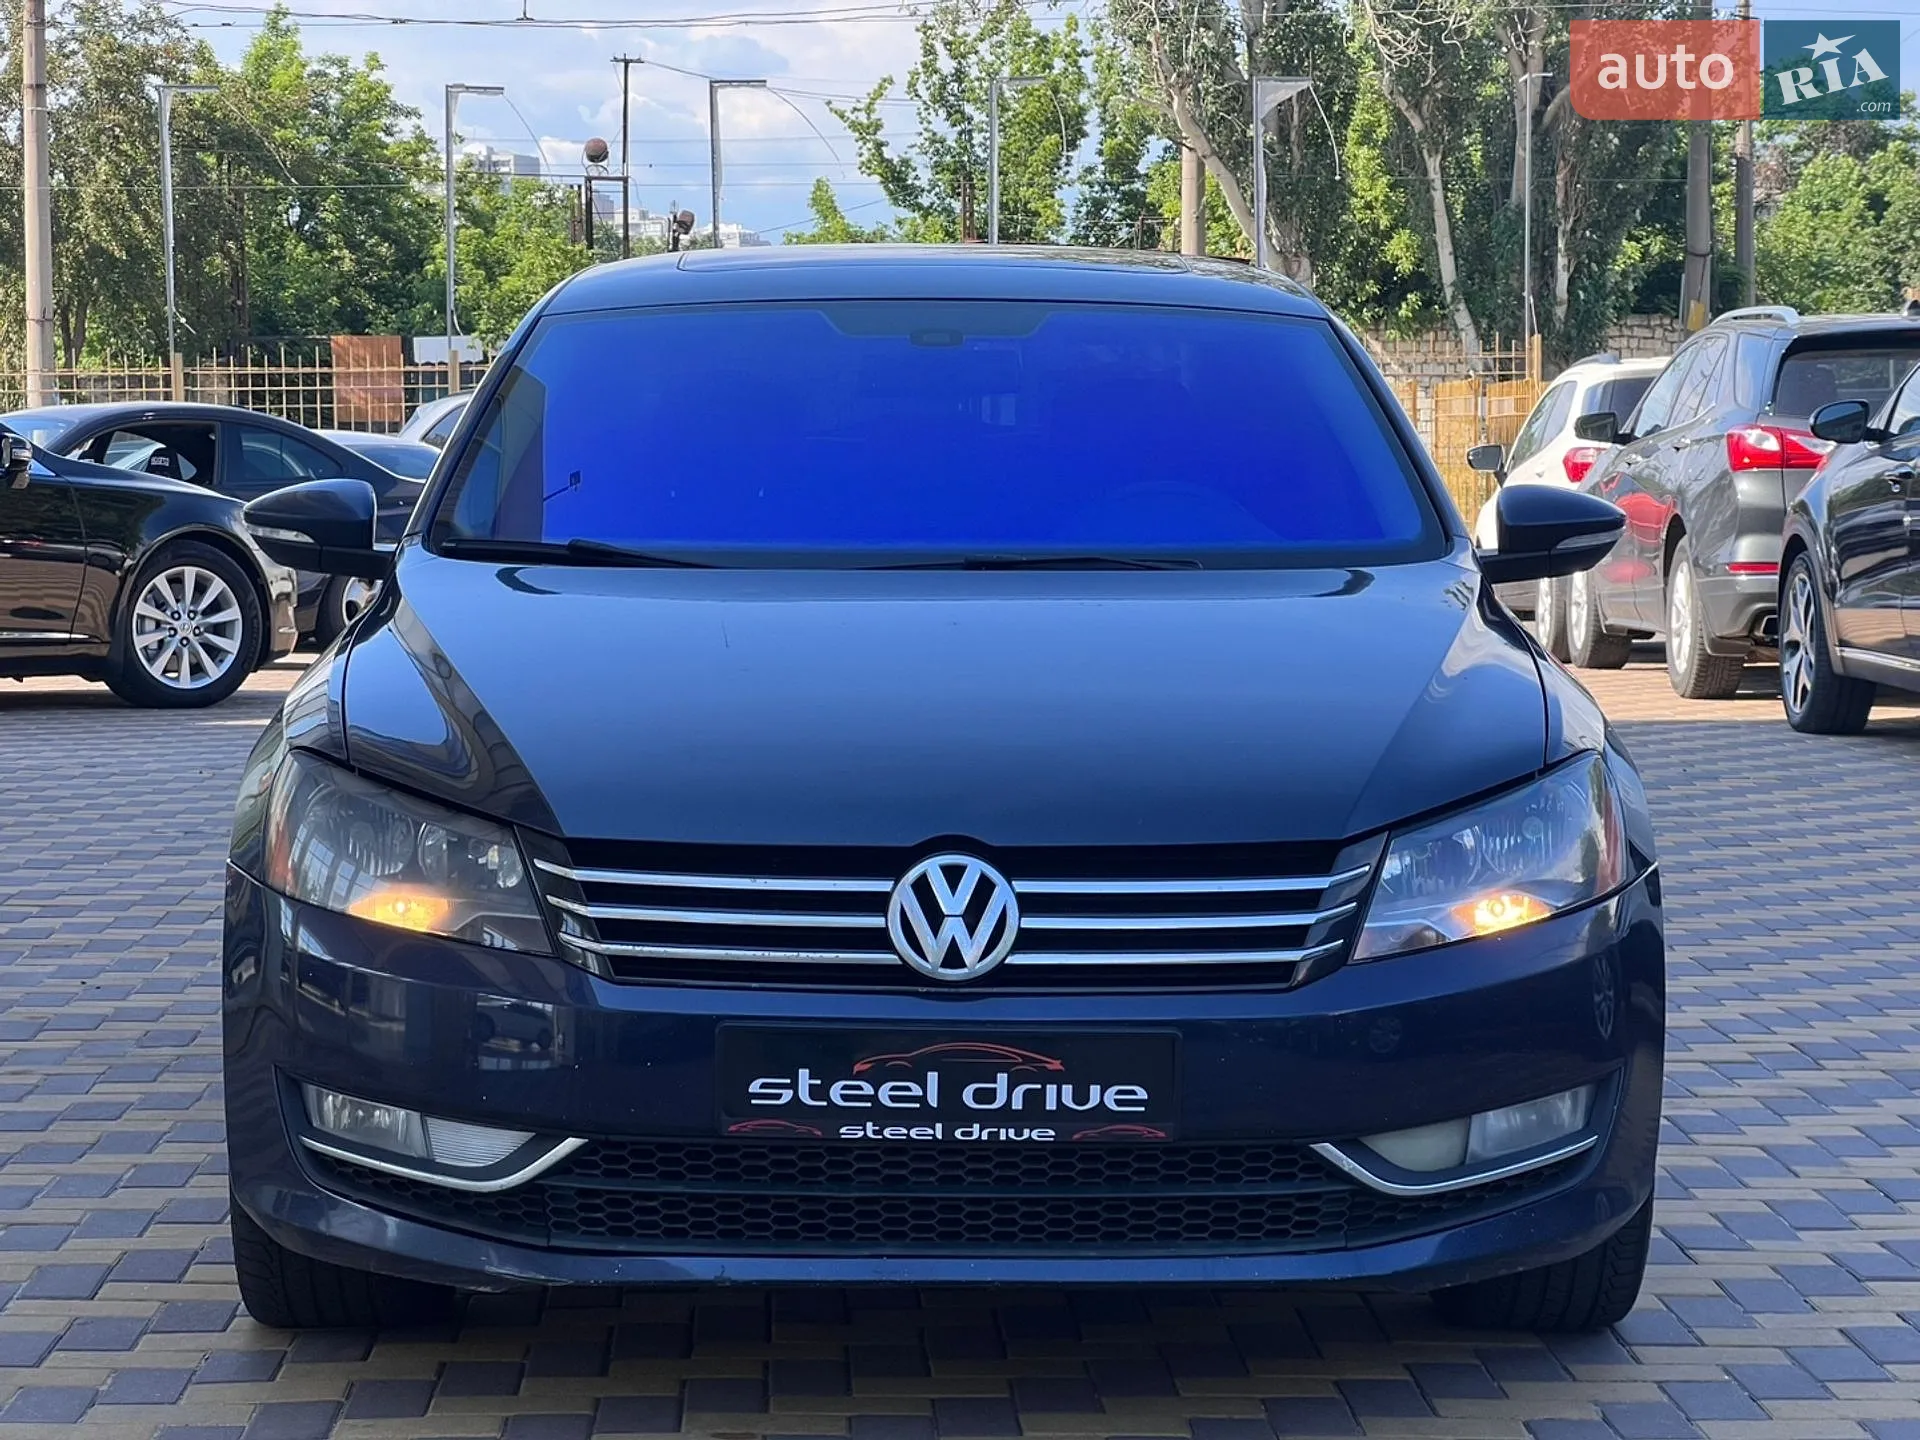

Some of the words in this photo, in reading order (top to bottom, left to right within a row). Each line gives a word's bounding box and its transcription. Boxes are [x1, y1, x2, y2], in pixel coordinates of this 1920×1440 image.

[748, 1068, 939, 1108] steel
[962, 1072, 1149, 1112] drive
[839, 1121, 943, 1141] steel
[954, 1123, 1056, 1142] drive
